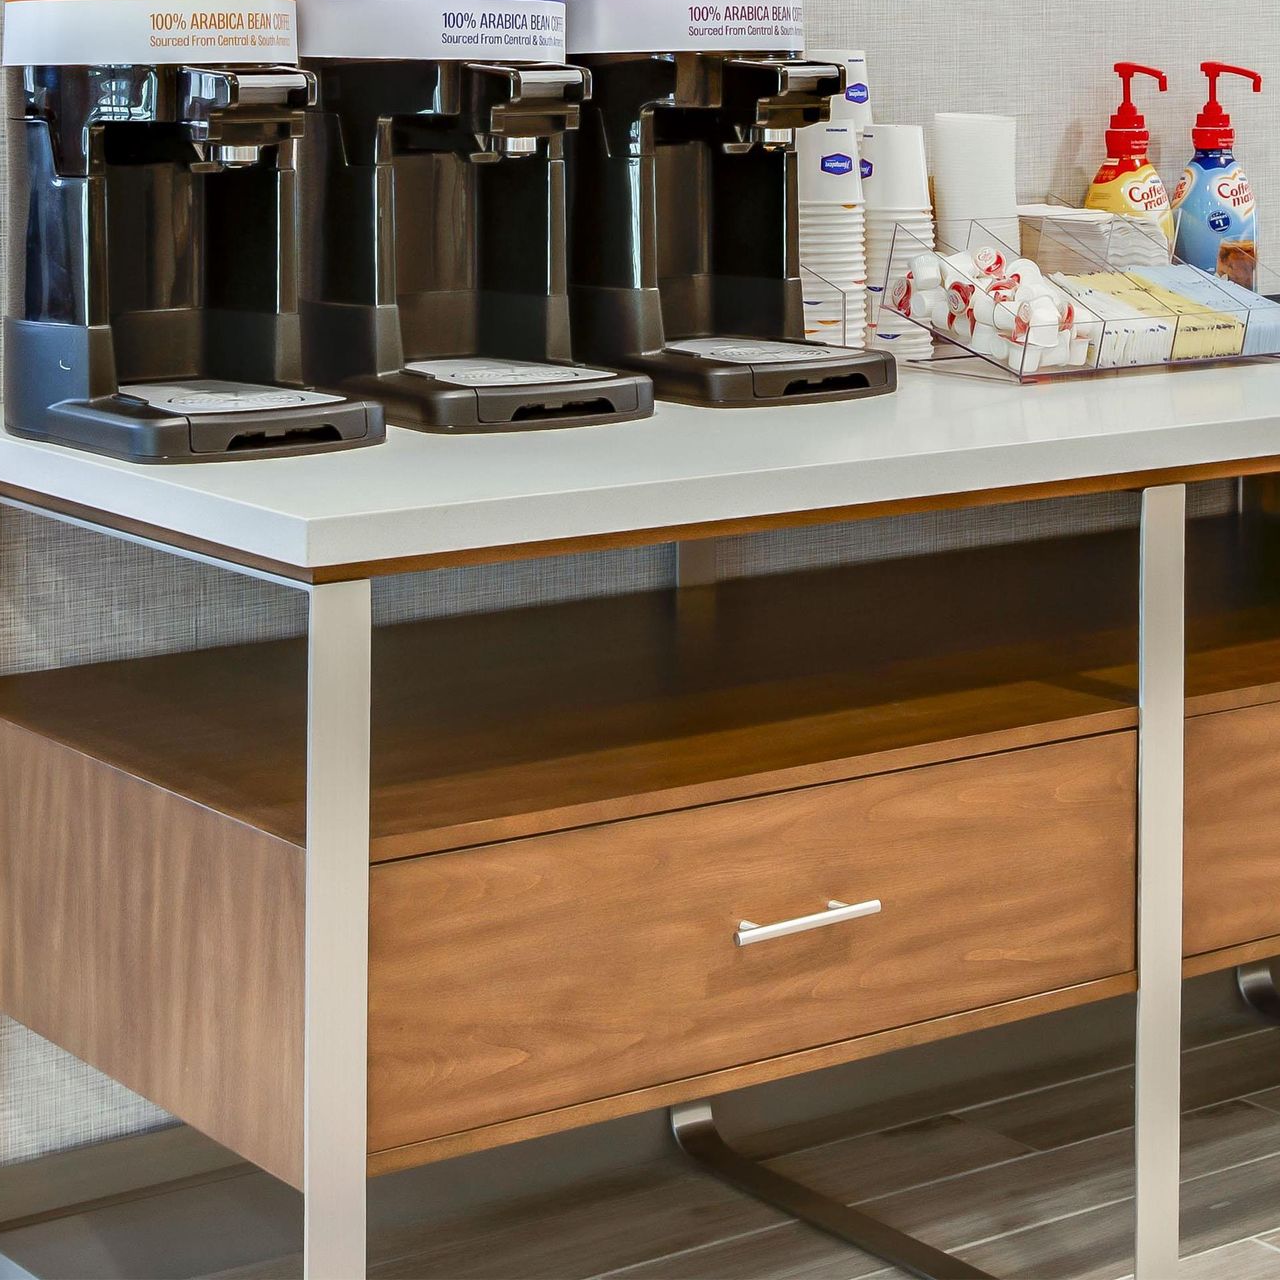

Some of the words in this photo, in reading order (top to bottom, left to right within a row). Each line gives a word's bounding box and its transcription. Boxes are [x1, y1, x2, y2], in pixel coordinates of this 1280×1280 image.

[150, 12, 187, 30] 100%
[190, 12, 245, 30] ARABICA
[247, 12, 272, 30] BEAN
[442, 12, 477, 29] 100%
[480, 13, 528, 30] ARABICA
[530, 14, 550, 31] BEAN
[688, 6, 721, 22] 100%
[724, 6, 770, 21] ARABICA
[772, 6, 791, 21] BEAN
[688, 25, 723, 36] Sourced
[725, 25, 746, 36] From
[747, 25, 773, 36] Central
[774, 25, 780, 36] &
[150, 35, 189, 47] Sourced
[191, 34, 216, 46] From
[218, 34, 248, 46] Central
[250, 35, 257, 46] &
[441, 32, 479, 45] Sourced
[480, 33, 502, 45] From
[504, 33, 531, 46] Central
[532, 34, 538, 46] &
